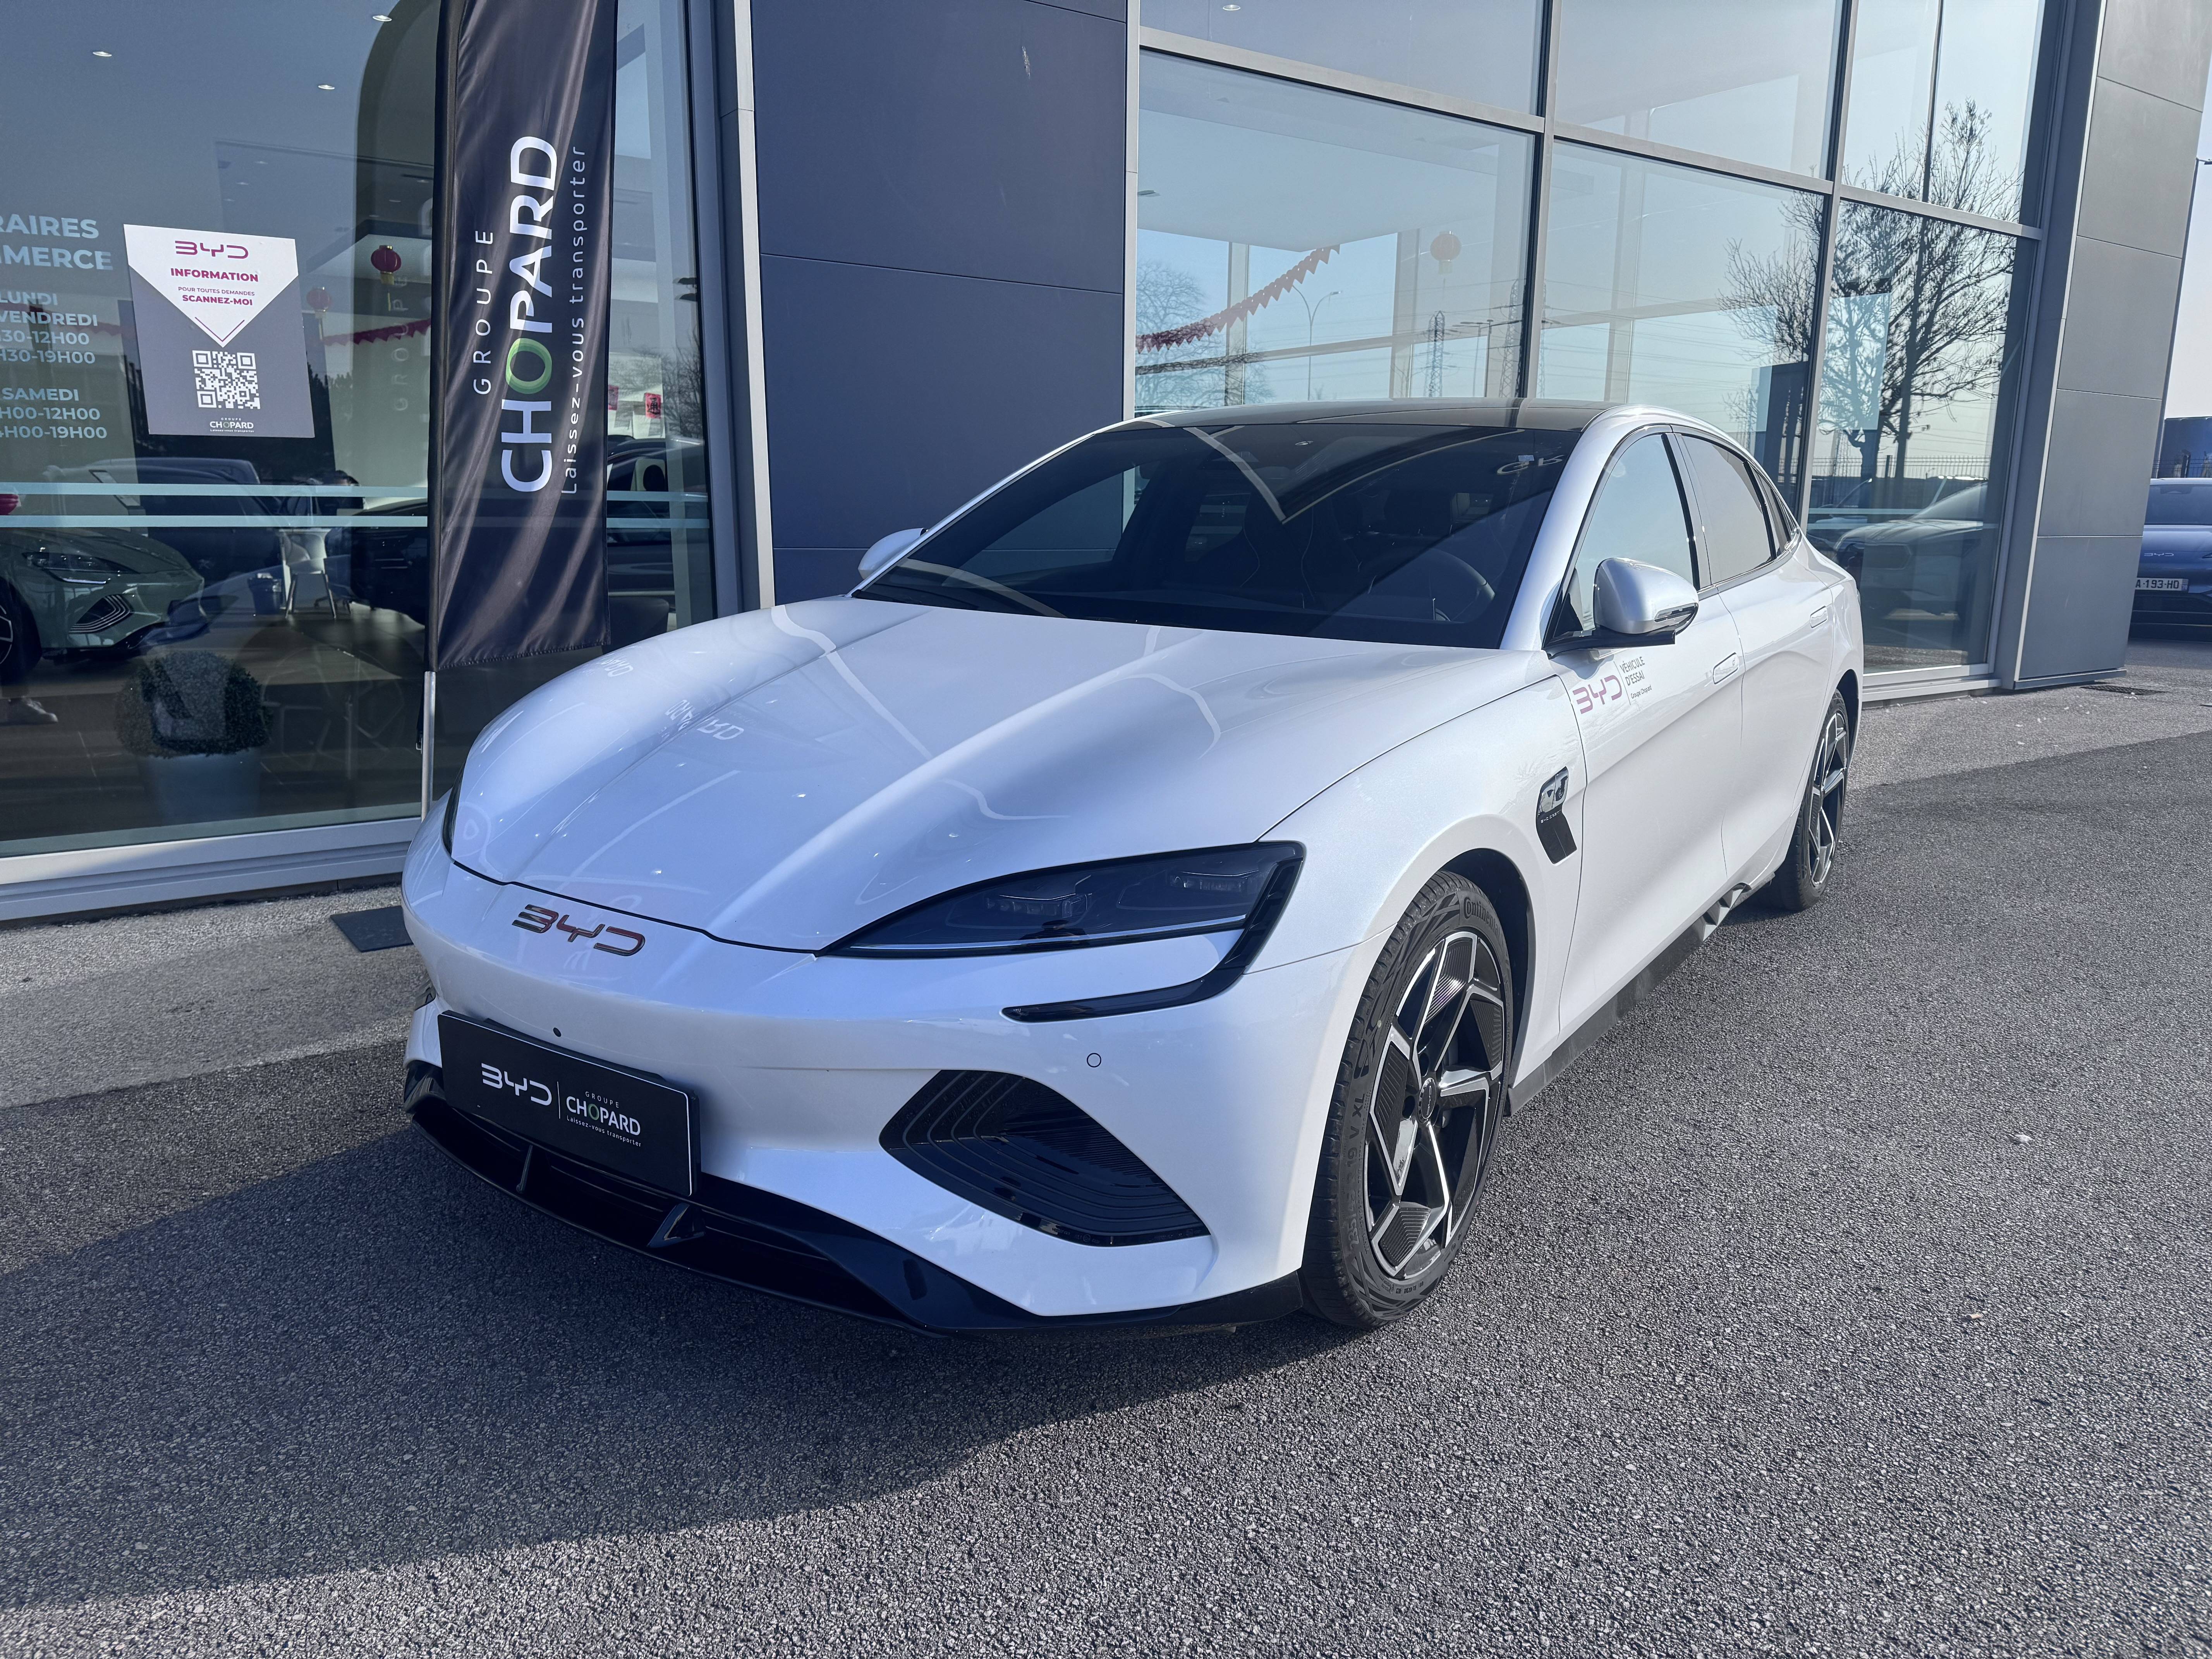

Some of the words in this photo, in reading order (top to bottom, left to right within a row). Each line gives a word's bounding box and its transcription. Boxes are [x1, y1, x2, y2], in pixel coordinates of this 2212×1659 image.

[0, 214, 99, 239] AIRES
[569, 146, 587, 304] transporter
[0, 245, 113, 270] MERCE
[175, 240, 249, 259] BYD
[171, 268, 258, 282] INFORMATION
[182, 295, 252, 306] SCANNEZ-MOI
[473, 231, 493, 395] GROUPE
[501, 136, 558, 493] CHOPARD
[0, 330, 89, 345] 30-12H00
[2, 388, 79, 401] SAMEDI
[561, 318, 584, 494] Laissez-vous
[1620, 656, 1645, 673] VÉHICULE
[1625, 670, 1645, 686] D'ESSAI
[1573, 675, 1622, 714] BYD
[512, 904, 645, 957] BYD
[481, 1063, 552, 1106] BYD
[585, 1091, 619, 1108] GROUPE
[1352, 1093, 1365, 1118] XL
[566, 1096, 641, 1135] CHOPARD
[567, 1115, 605, 1133] Laissez-vous
[607, 1130, 641, 1147] transporter
